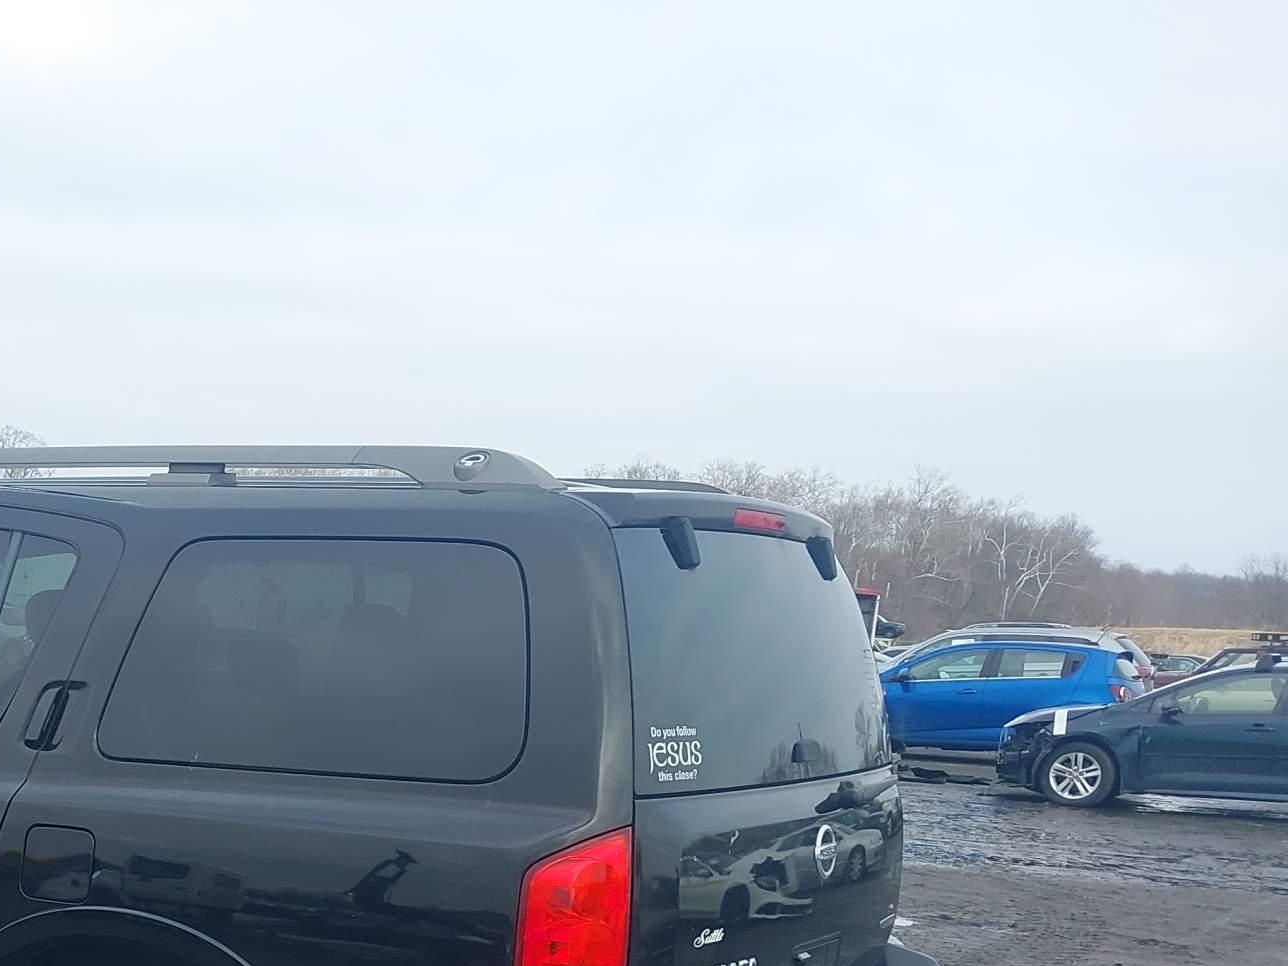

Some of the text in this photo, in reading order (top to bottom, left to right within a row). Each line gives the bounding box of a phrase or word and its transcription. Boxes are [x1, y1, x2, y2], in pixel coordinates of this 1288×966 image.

[650, 725, 697, 740] Do you follow
[657, 768, 699, 782] this close?
